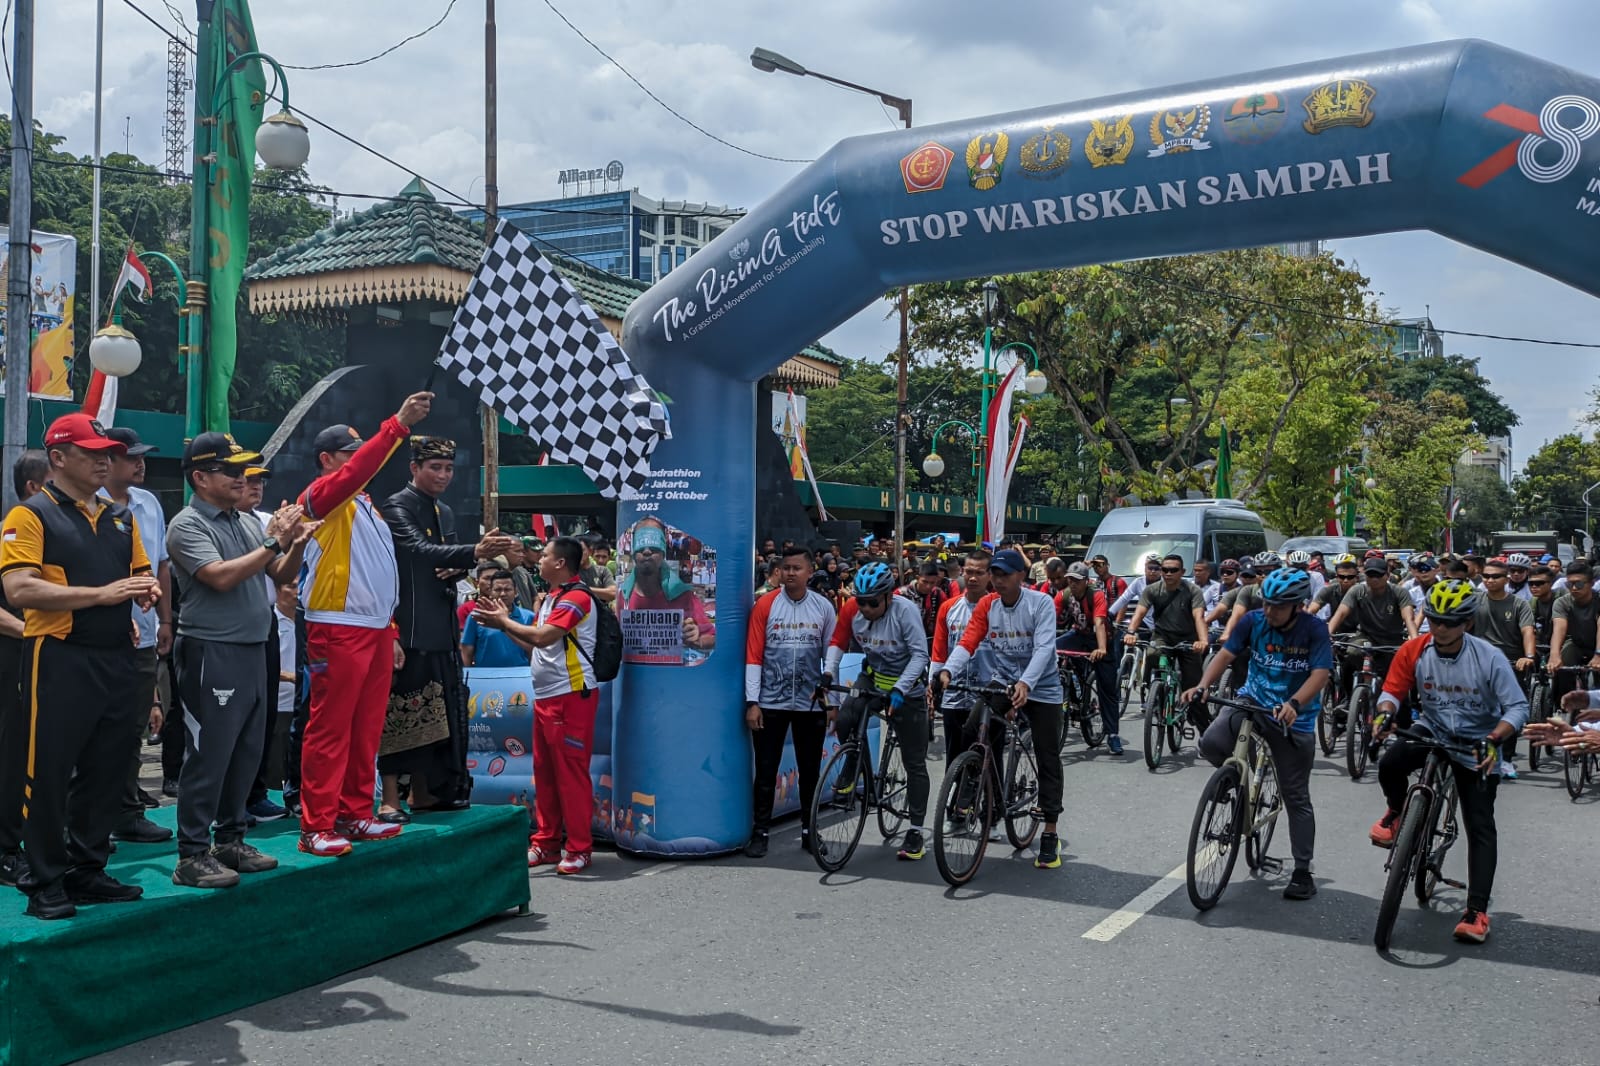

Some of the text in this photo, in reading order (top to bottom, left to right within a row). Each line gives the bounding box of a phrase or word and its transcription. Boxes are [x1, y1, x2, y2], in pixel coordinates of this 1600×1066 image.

[558, 168, 604, 184] Allianz
[880, 152, 1393, 245] STOP WARISKAN SAMPAH
[682, 234, 825, 341] A Grassroot Movement for Sustainability
[653, 297, 697, 342] The
[650, 480, 689, 489] Jakarta
[665, 491, 708, 500] Oktober
[881, 491, 951, 513] HLANG
[636, 502, 660, 511] 2023
[631, 611, 680, 625] Berjuang
